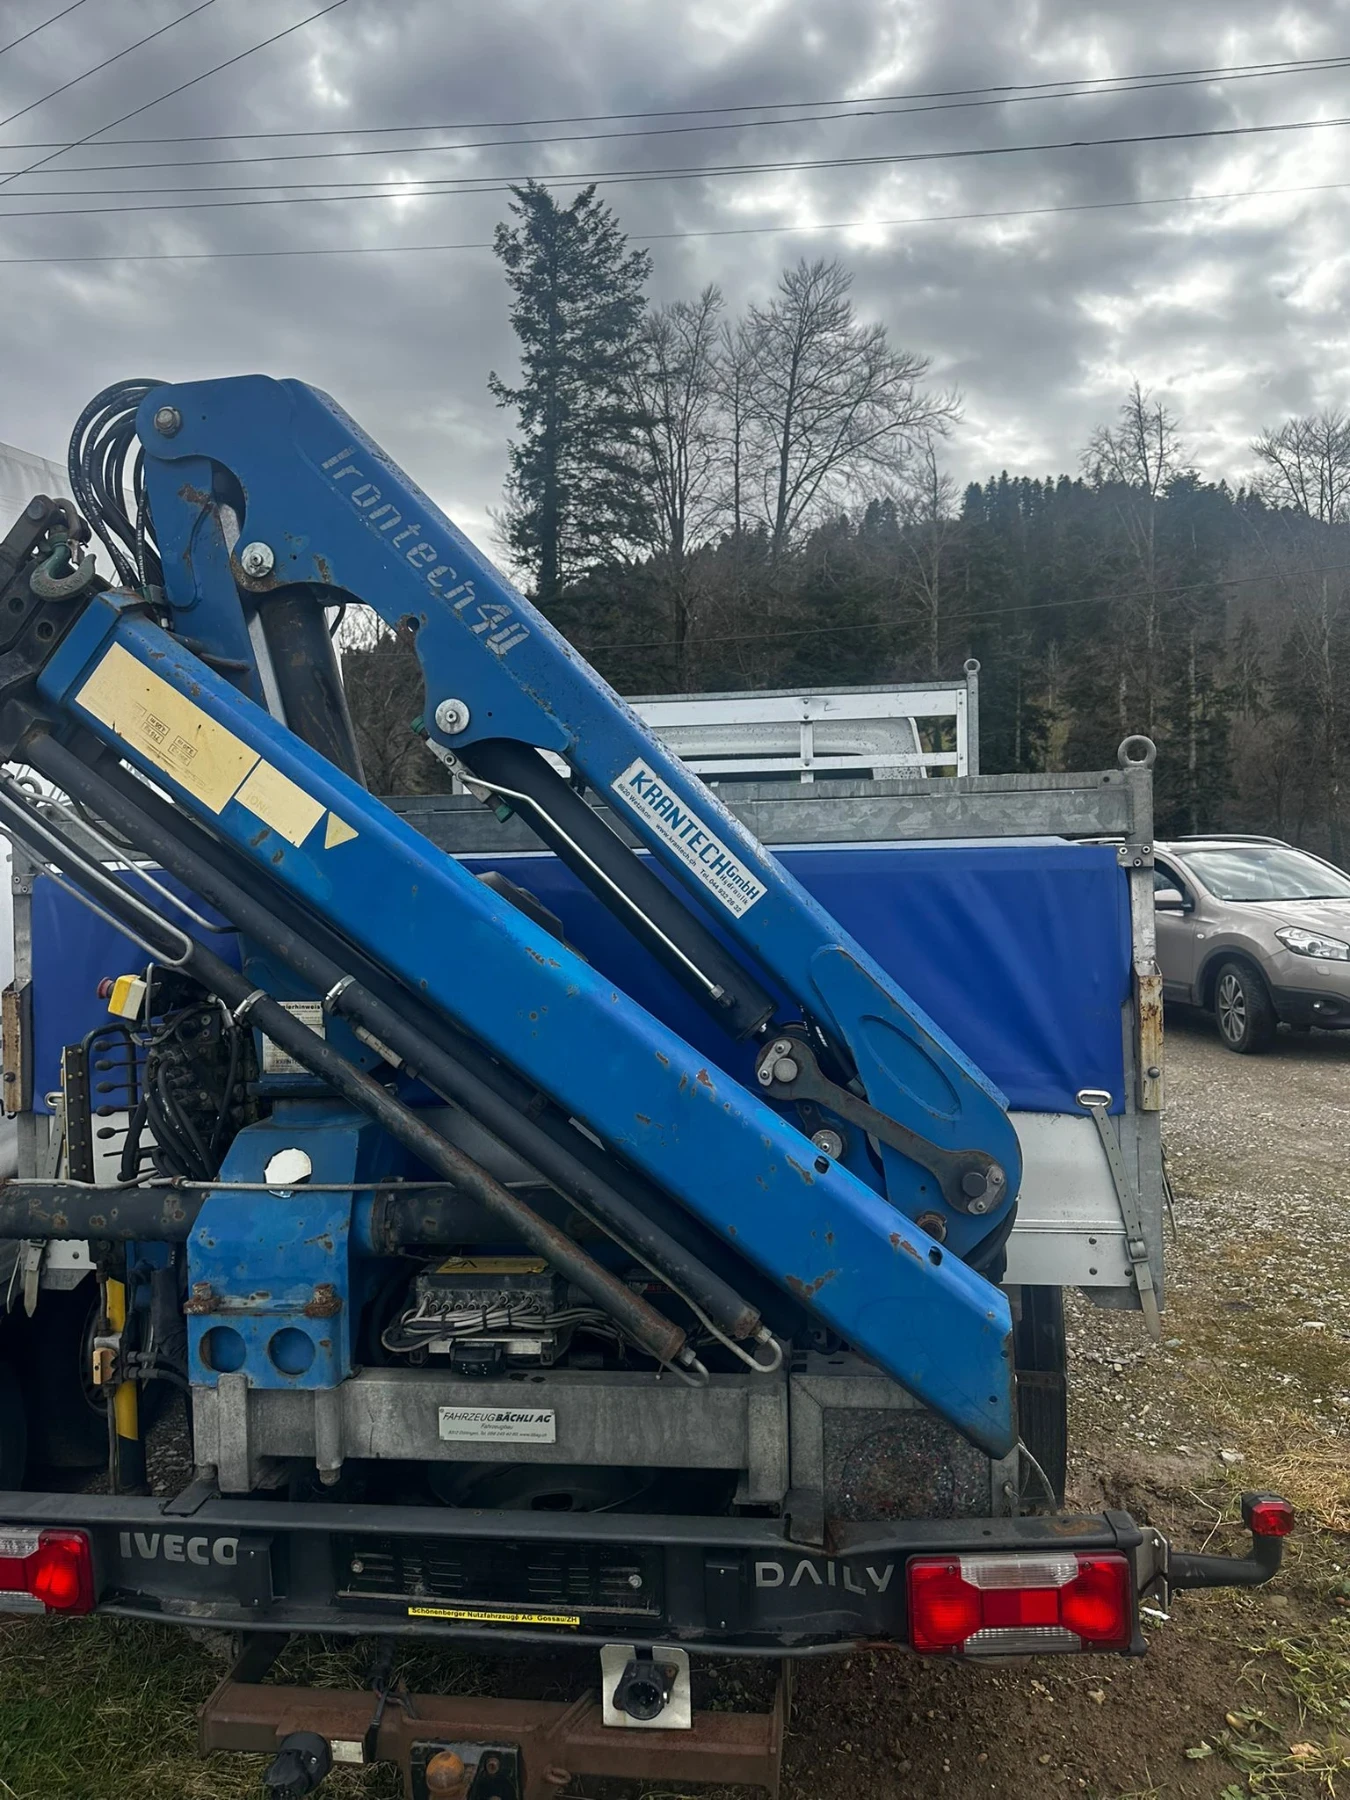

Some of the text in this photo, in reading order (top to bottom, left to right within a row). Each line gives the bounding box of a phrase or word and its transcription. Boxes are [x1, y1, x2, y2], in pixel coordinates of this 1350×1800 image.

[629, 794, 652, 820] Wetzikon
[655, 823, 697, 867] www.krantech.ch
[708, 878, 720, 890] 044
[720, 873, 749, 906] Hydraulik
[534, 1414, 552, 1423] AG
[119, 1531, 240, 1566] IVECO
[755, 1559, 895, 1597] DAILY
[412, 1607, 466, 1618] Schönenberger
[521, 1613, 533, 1621] AG
[536, 1615, 578, 1624] Gossau/ZH
